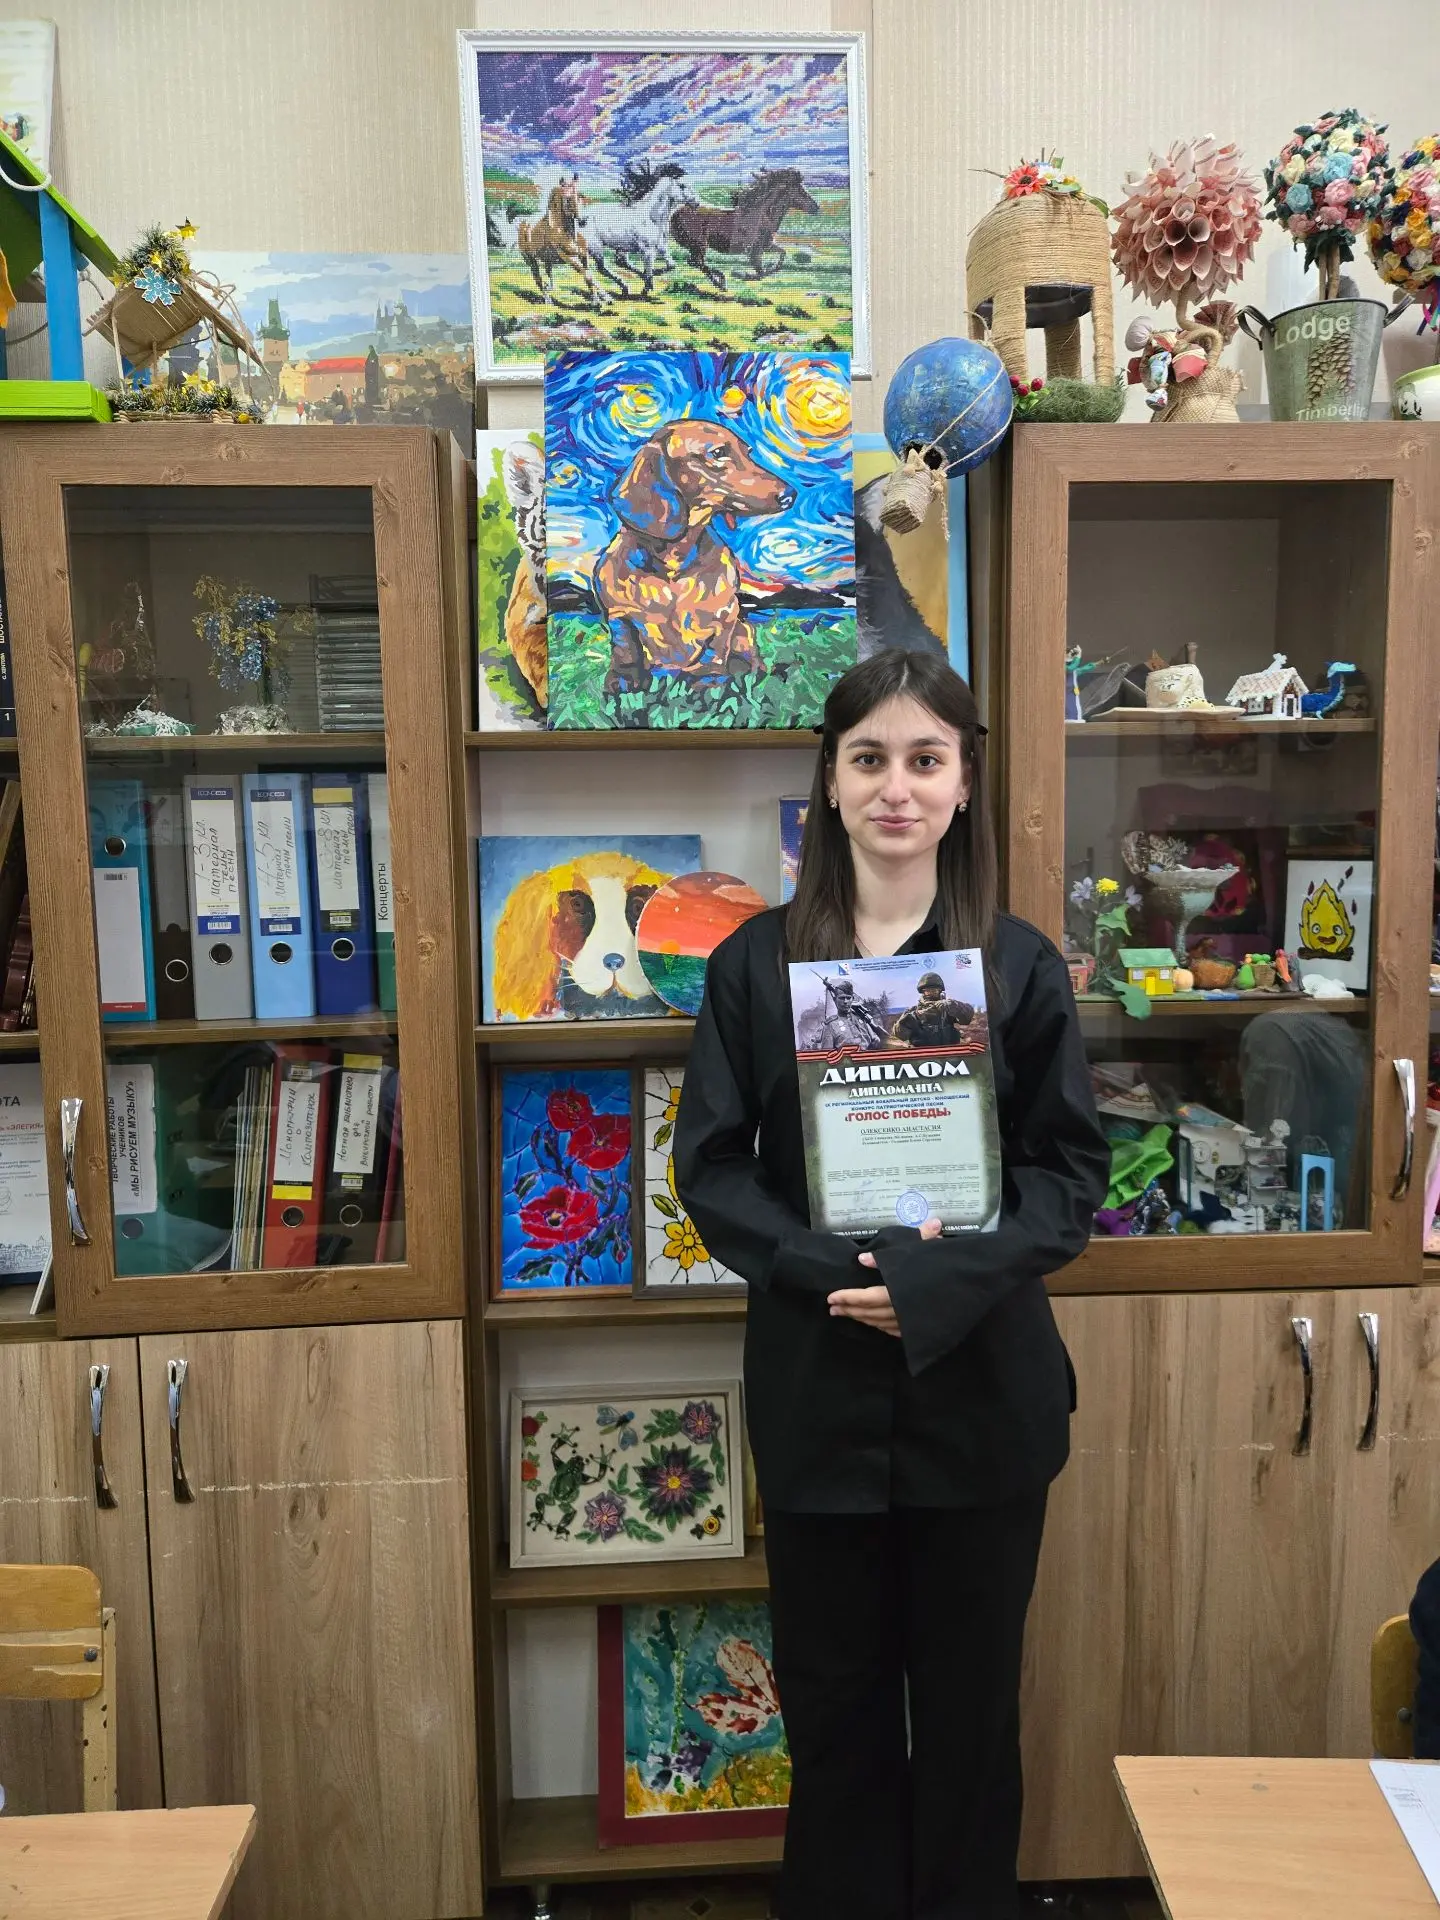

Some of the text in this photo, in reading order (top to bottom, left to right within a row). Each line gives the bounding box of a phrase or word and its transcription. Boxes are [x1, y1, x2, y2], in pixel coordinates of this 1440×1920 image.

[1275, 314, 1352, 350] Lodge
[378, 863, 389, 920] Концерты
[820, 1060, 970, 1085] ДИПЛОМ
[849, 1083, 942, 1098] ДИПЛОМАНТА
[108, 1097, 116, 1131] РАБОТЫ
[118, 1116, 126, 1158] УЧЕНИКОВ
[126, 1081, 139, 1197] «МЫ РИСУЕМ МУЗЫКУ»
